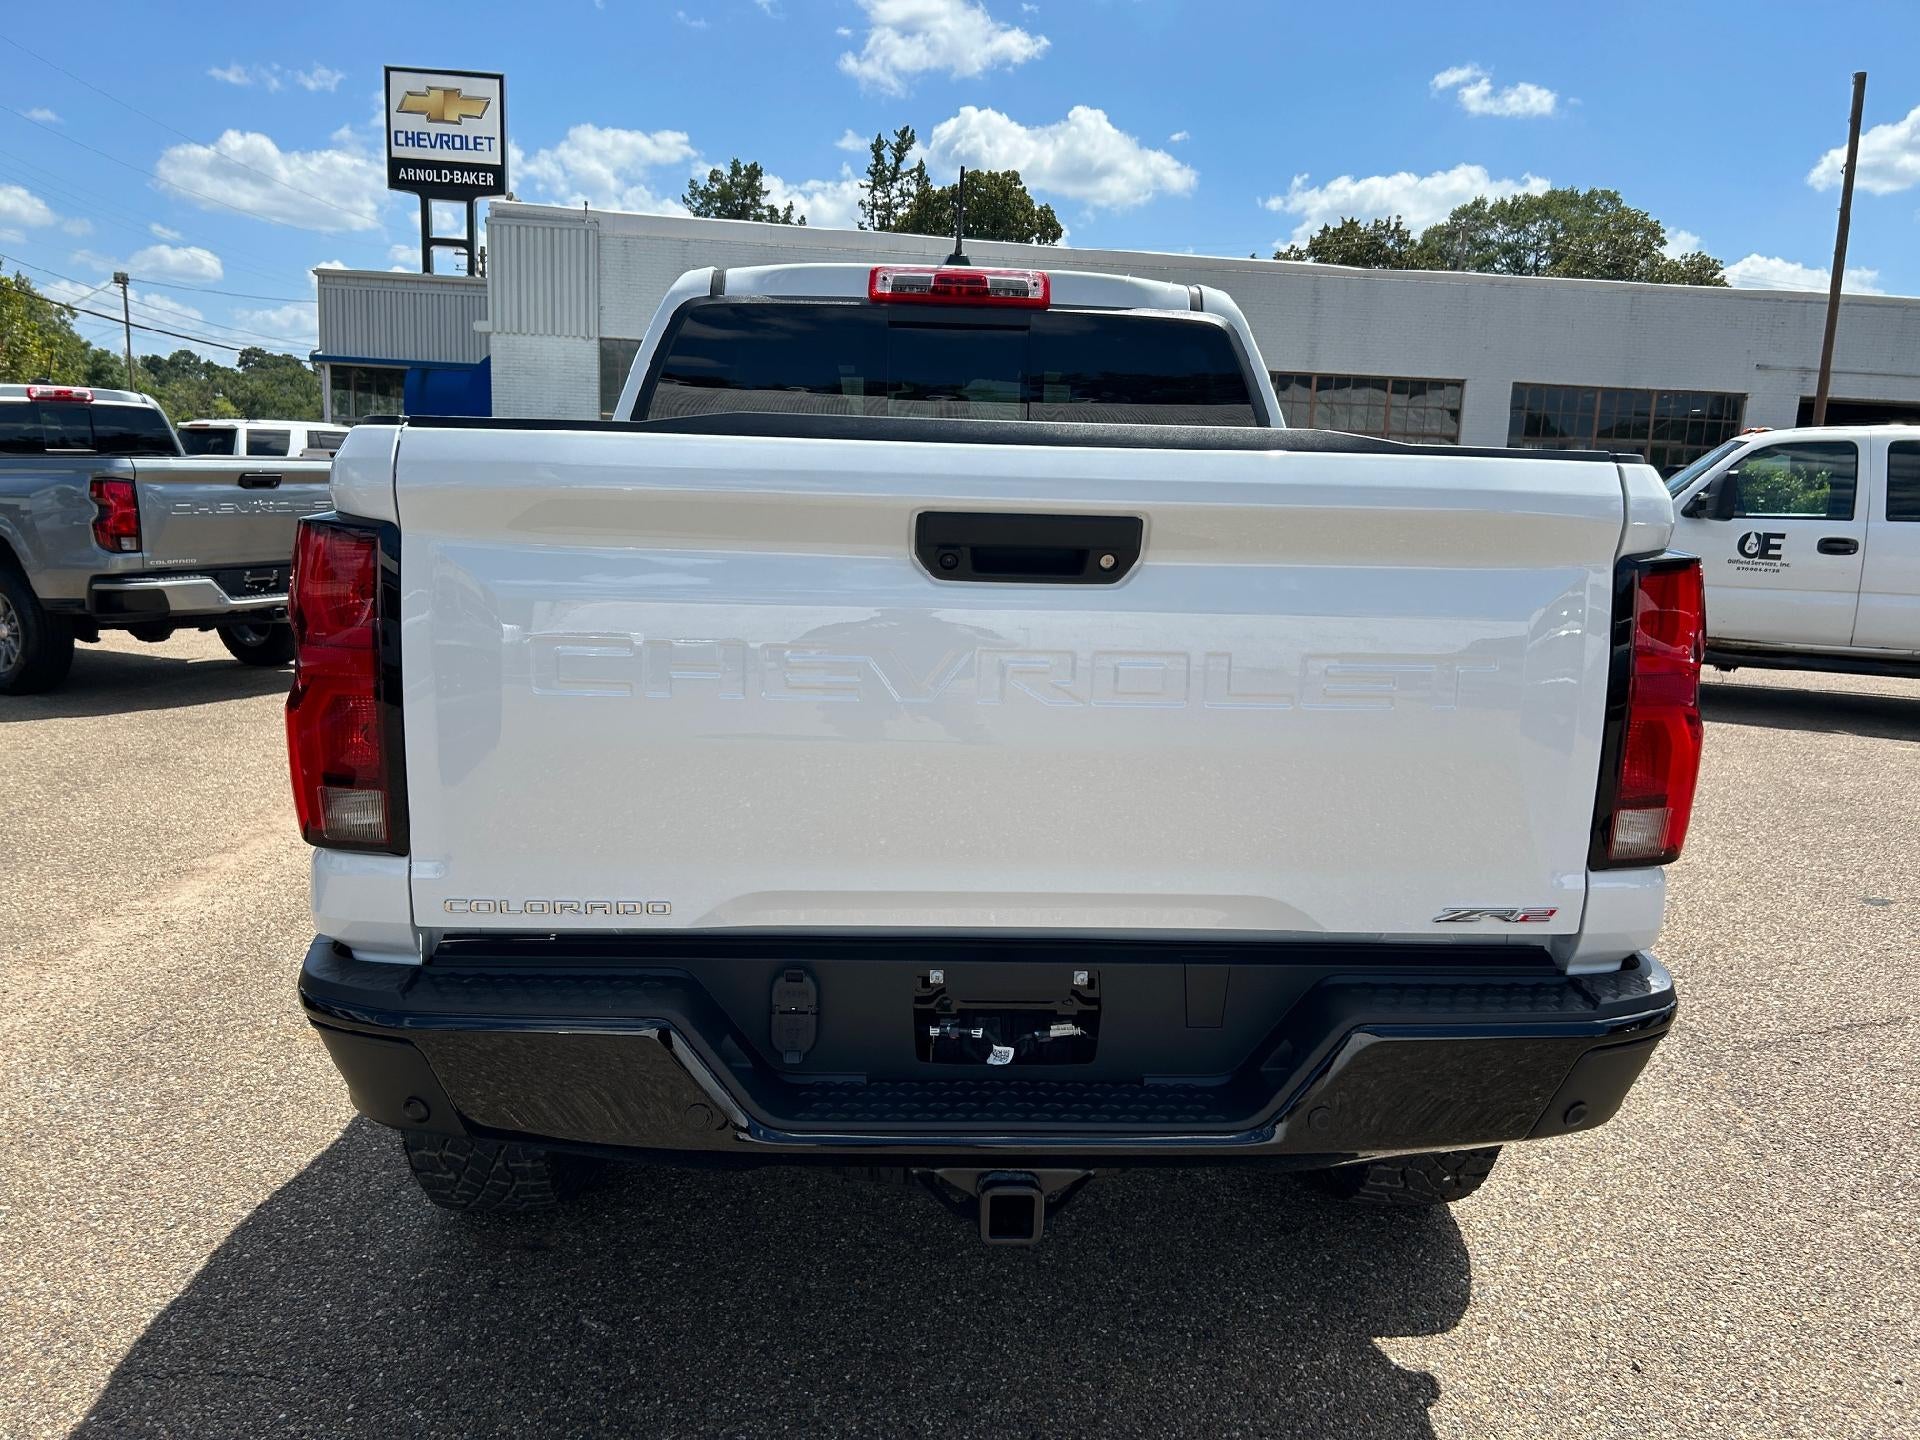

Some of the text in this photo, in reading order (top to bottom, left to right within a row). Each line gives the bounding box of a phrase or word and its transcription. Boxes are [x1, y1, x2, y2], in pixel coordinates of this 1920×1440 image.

[394, 130, 495, 152] CHEVROLET
[398, 167, 495, 186] ARNOLD-BAKER
[171, 499, 333, 515] CHEVROLE
[149, 558, 197, 566] COLORADO
[1727, 558, 1750, 566] Oilfield
[529, 632, 1500, 711] CHEVROLET
[443, 898, 673, 916] COLORADO
[1432, 907, 1560, 923] ZR2
